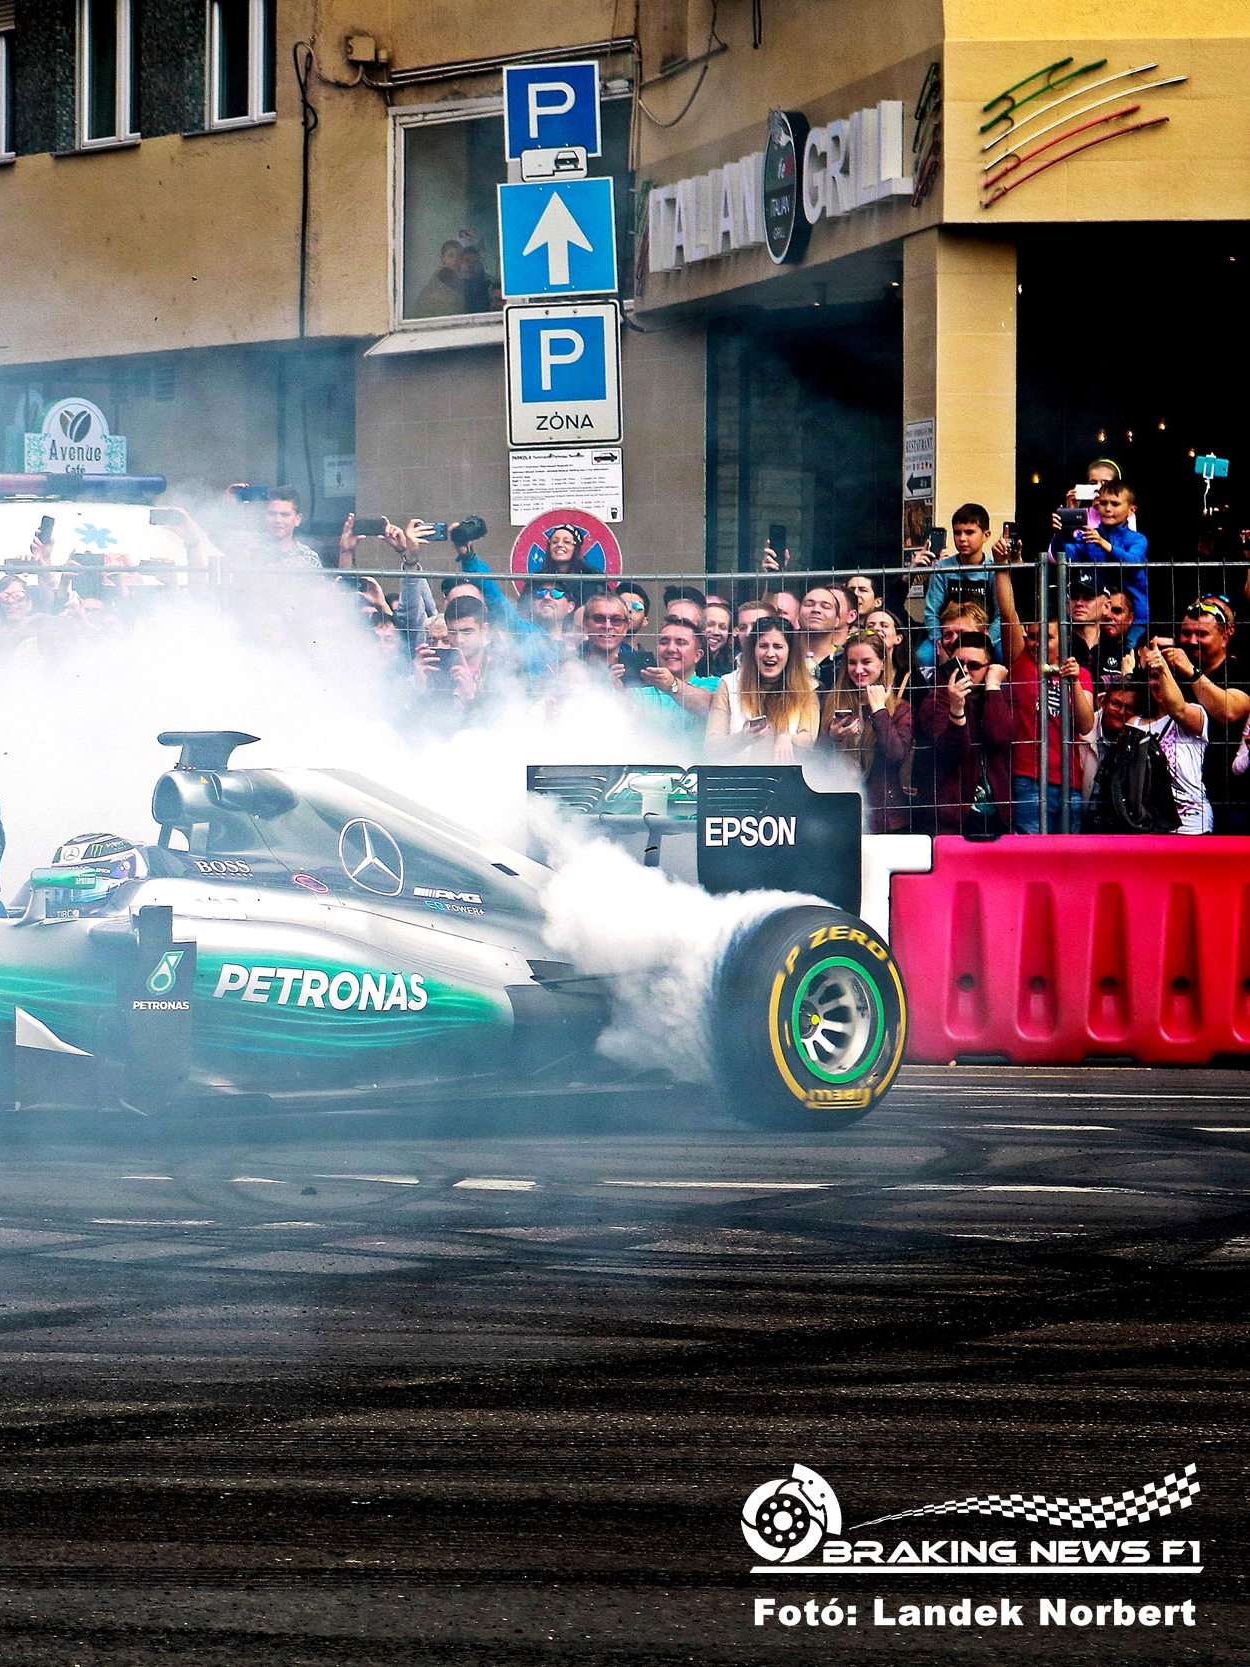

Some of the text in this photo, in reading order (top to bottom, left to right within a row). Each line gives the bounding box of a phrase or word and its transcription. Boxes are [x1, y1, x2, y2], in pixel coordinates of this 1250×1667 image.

[527, 82, 577, 139] P
[650, 100, 914, 273] ITALIAN GRILL
[539, 328, 585, 392] P
[536, 411, 594, 431] ZÓNA
[49, 439, 102, 461] Avenue
[704, 816, 797, 848] EPSON
[194, 859, 251, 874] BOSS
[435, 889, 483, 904] AMG
[808, 925, 889, 961] ZERO
[212, 962, 429, 1012] PETRONAS
[132, 1000, 190, 1011] PETRONAS
